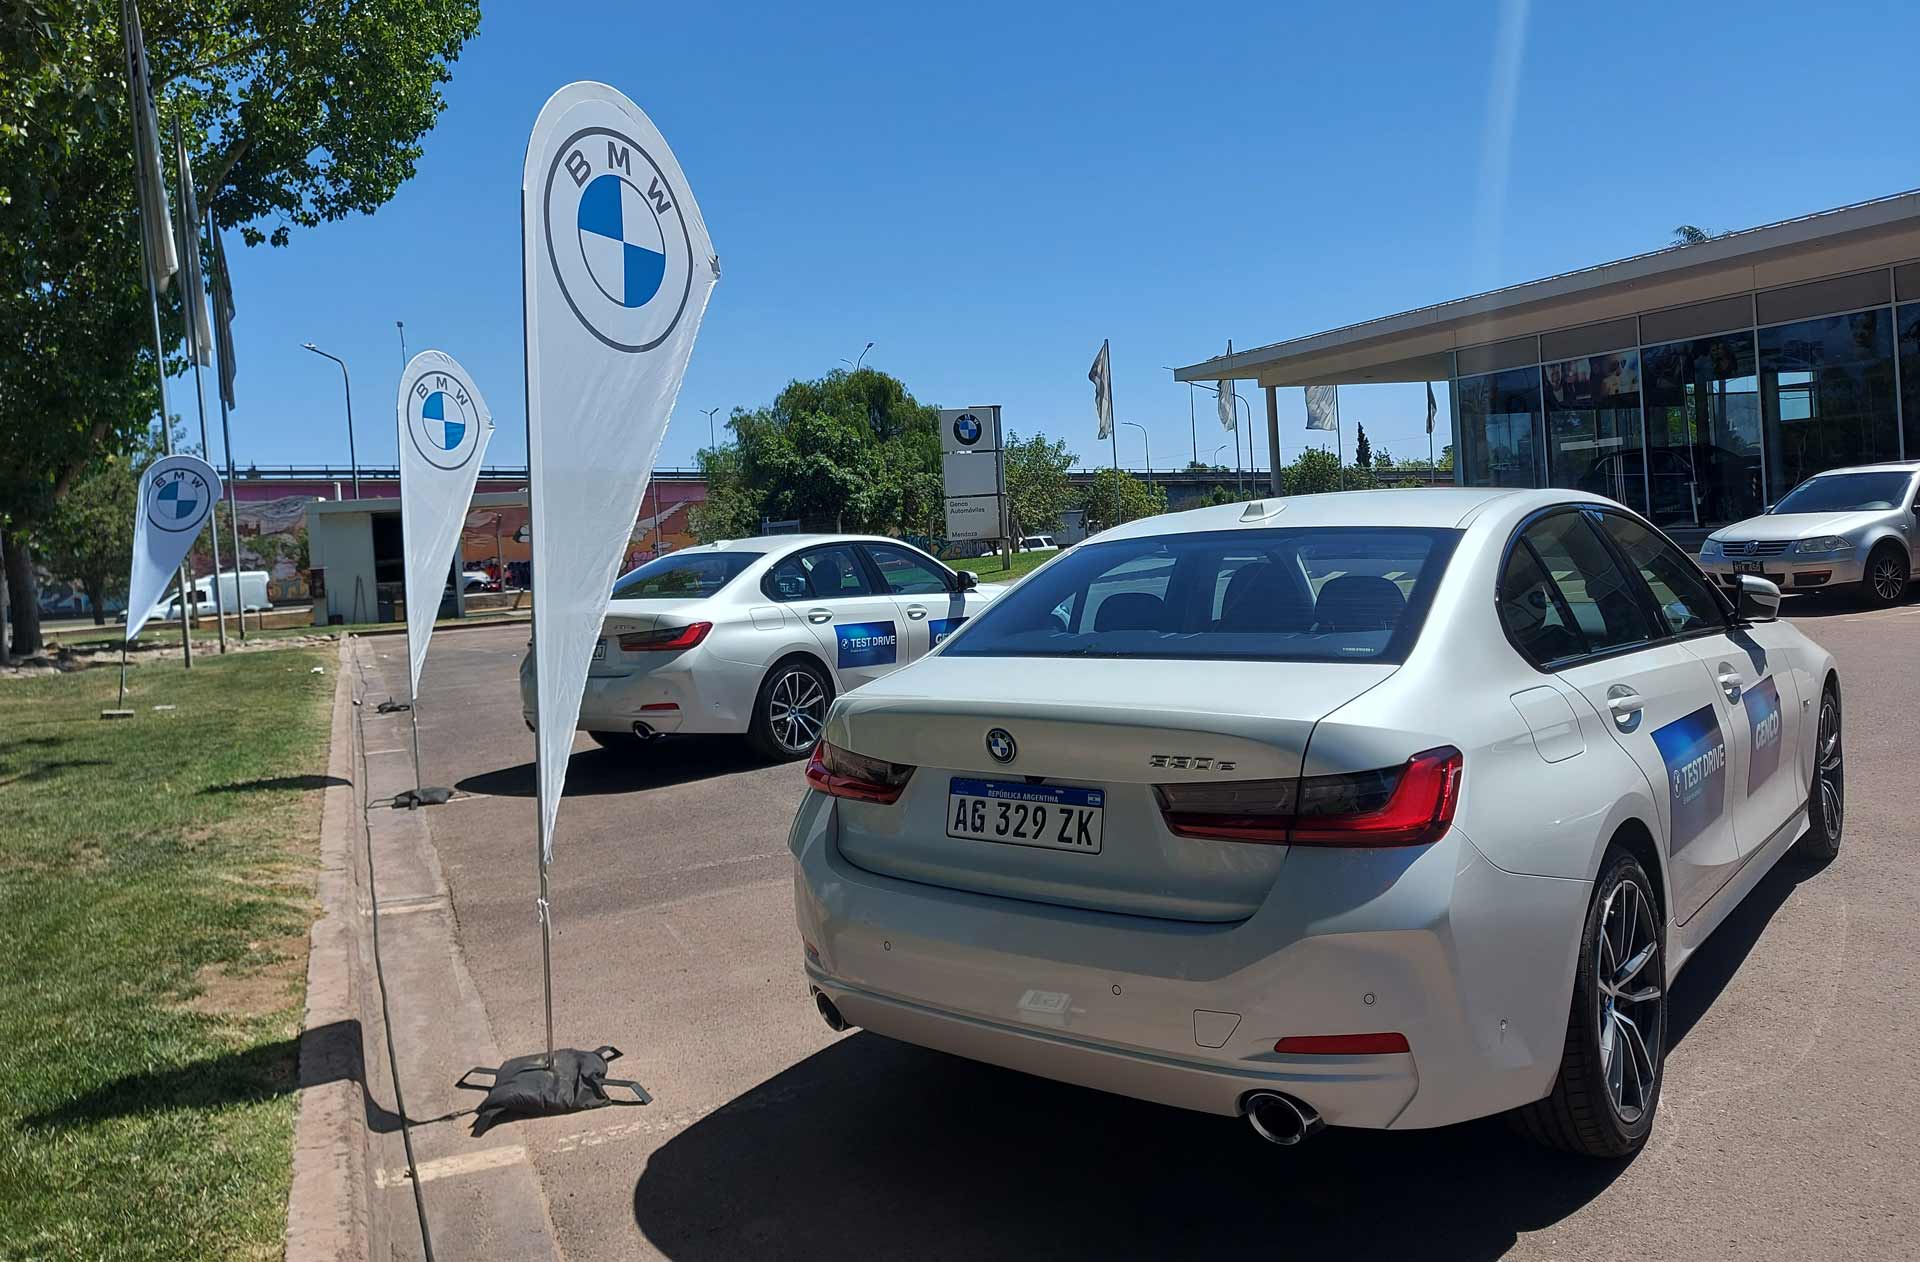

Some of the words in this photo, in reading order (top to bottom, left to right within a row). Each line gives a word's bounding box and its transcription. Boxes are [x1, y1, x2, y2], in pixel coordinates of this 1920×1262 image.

[564, 140, 672, 215] BMW
[416, 376, 469, 406] BMW
[155, 471, 203, 488] BMW
[850, 637, 872, 648] TEST
[872, 635, 896, 646] DRIVE
[1755, 710, 1779, 751] GENCO
[1681, 757, 1702, 791] TEST
[1702, 743, 1725, 778] DRIVE
[987, 789, 1022, 800] REPÚBLICA
[1022, 793, 1059, 803] ARGENTINA
[954, 798, 987, 833] AG
[995, 801, 1047, 840] 329
[1057, 807, 1095, 846] ZK
